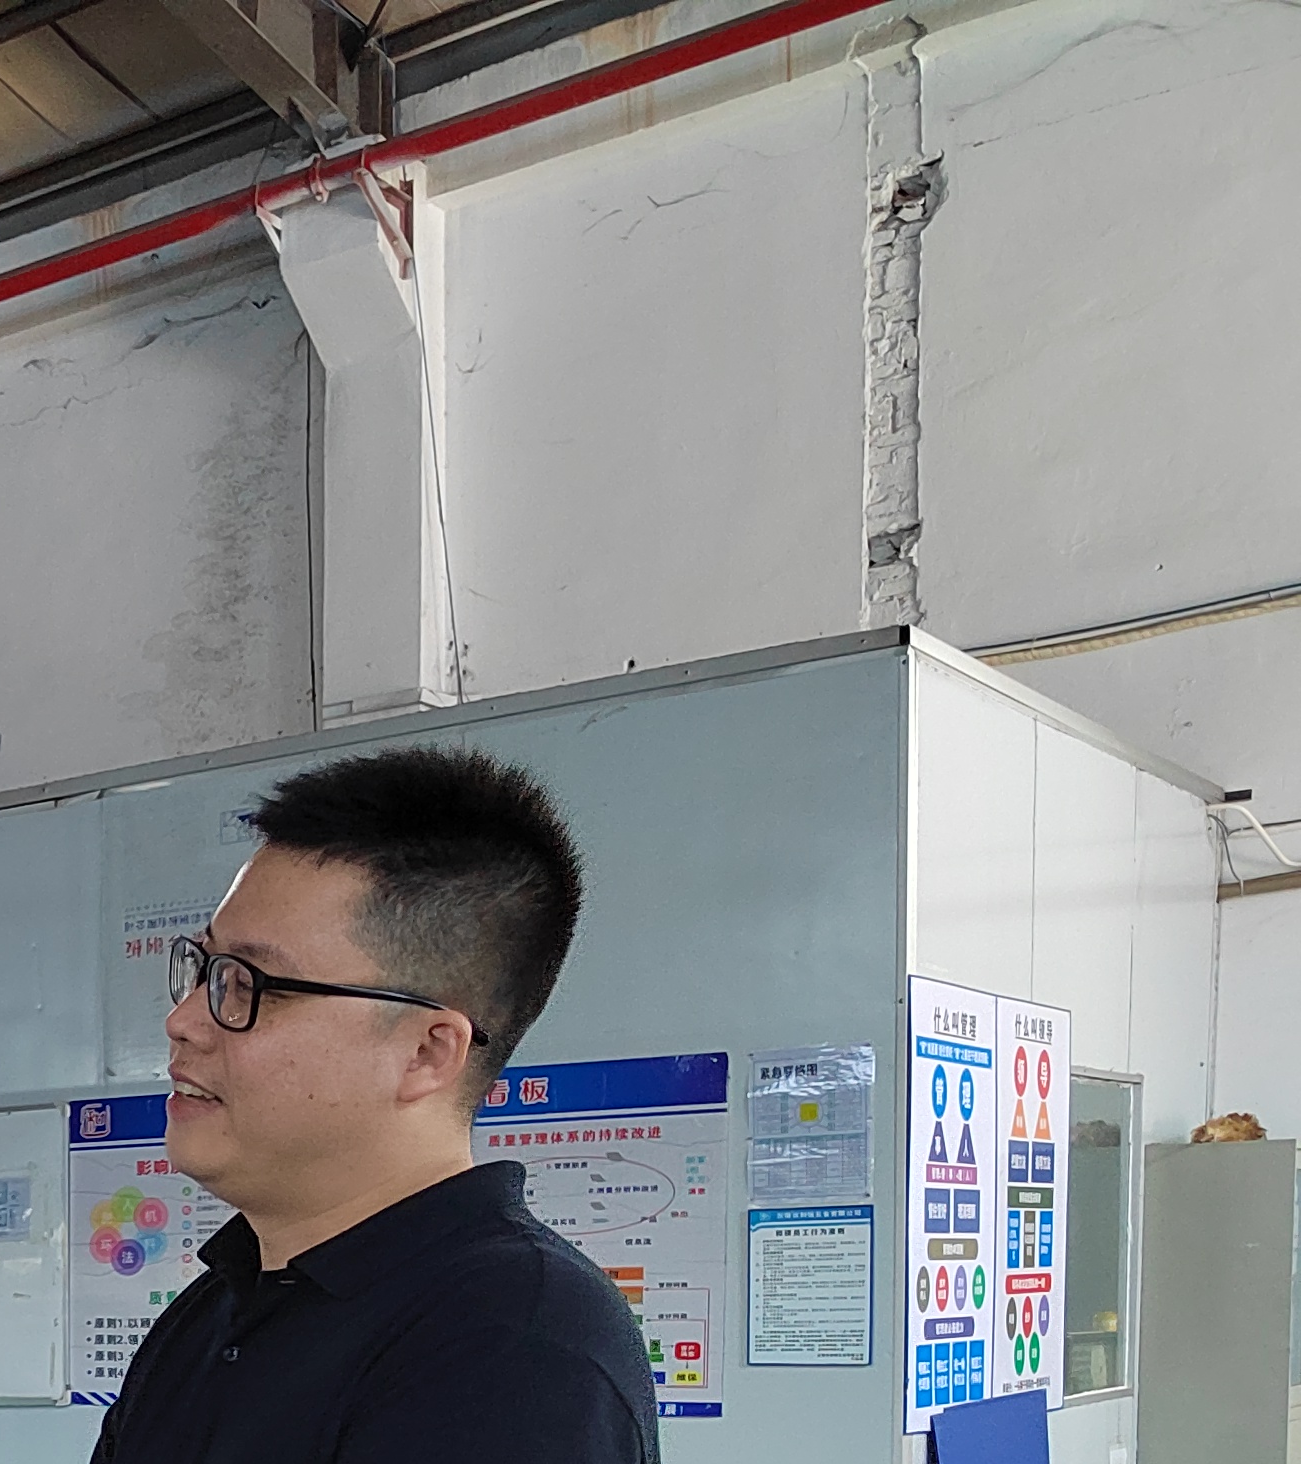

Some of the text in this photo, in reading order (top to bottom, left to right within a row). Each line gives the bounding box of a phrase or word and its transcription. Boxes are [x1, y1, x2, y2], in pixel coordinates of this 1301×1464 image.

[934, 1006, 977, 1038] 什么叫管理
[1015, 1013, 1052, 1042] 什么叫领导
[488, 1126, 663, 1147] 质量管理体系的持续改进
[136, 1159, 179, 1175] 影响
[121, 1251, 134, 1263] 法
[94, 1318, 156, 1329] 原则1.以顾
[94, 1334, 145, 1345] 原则2.领
